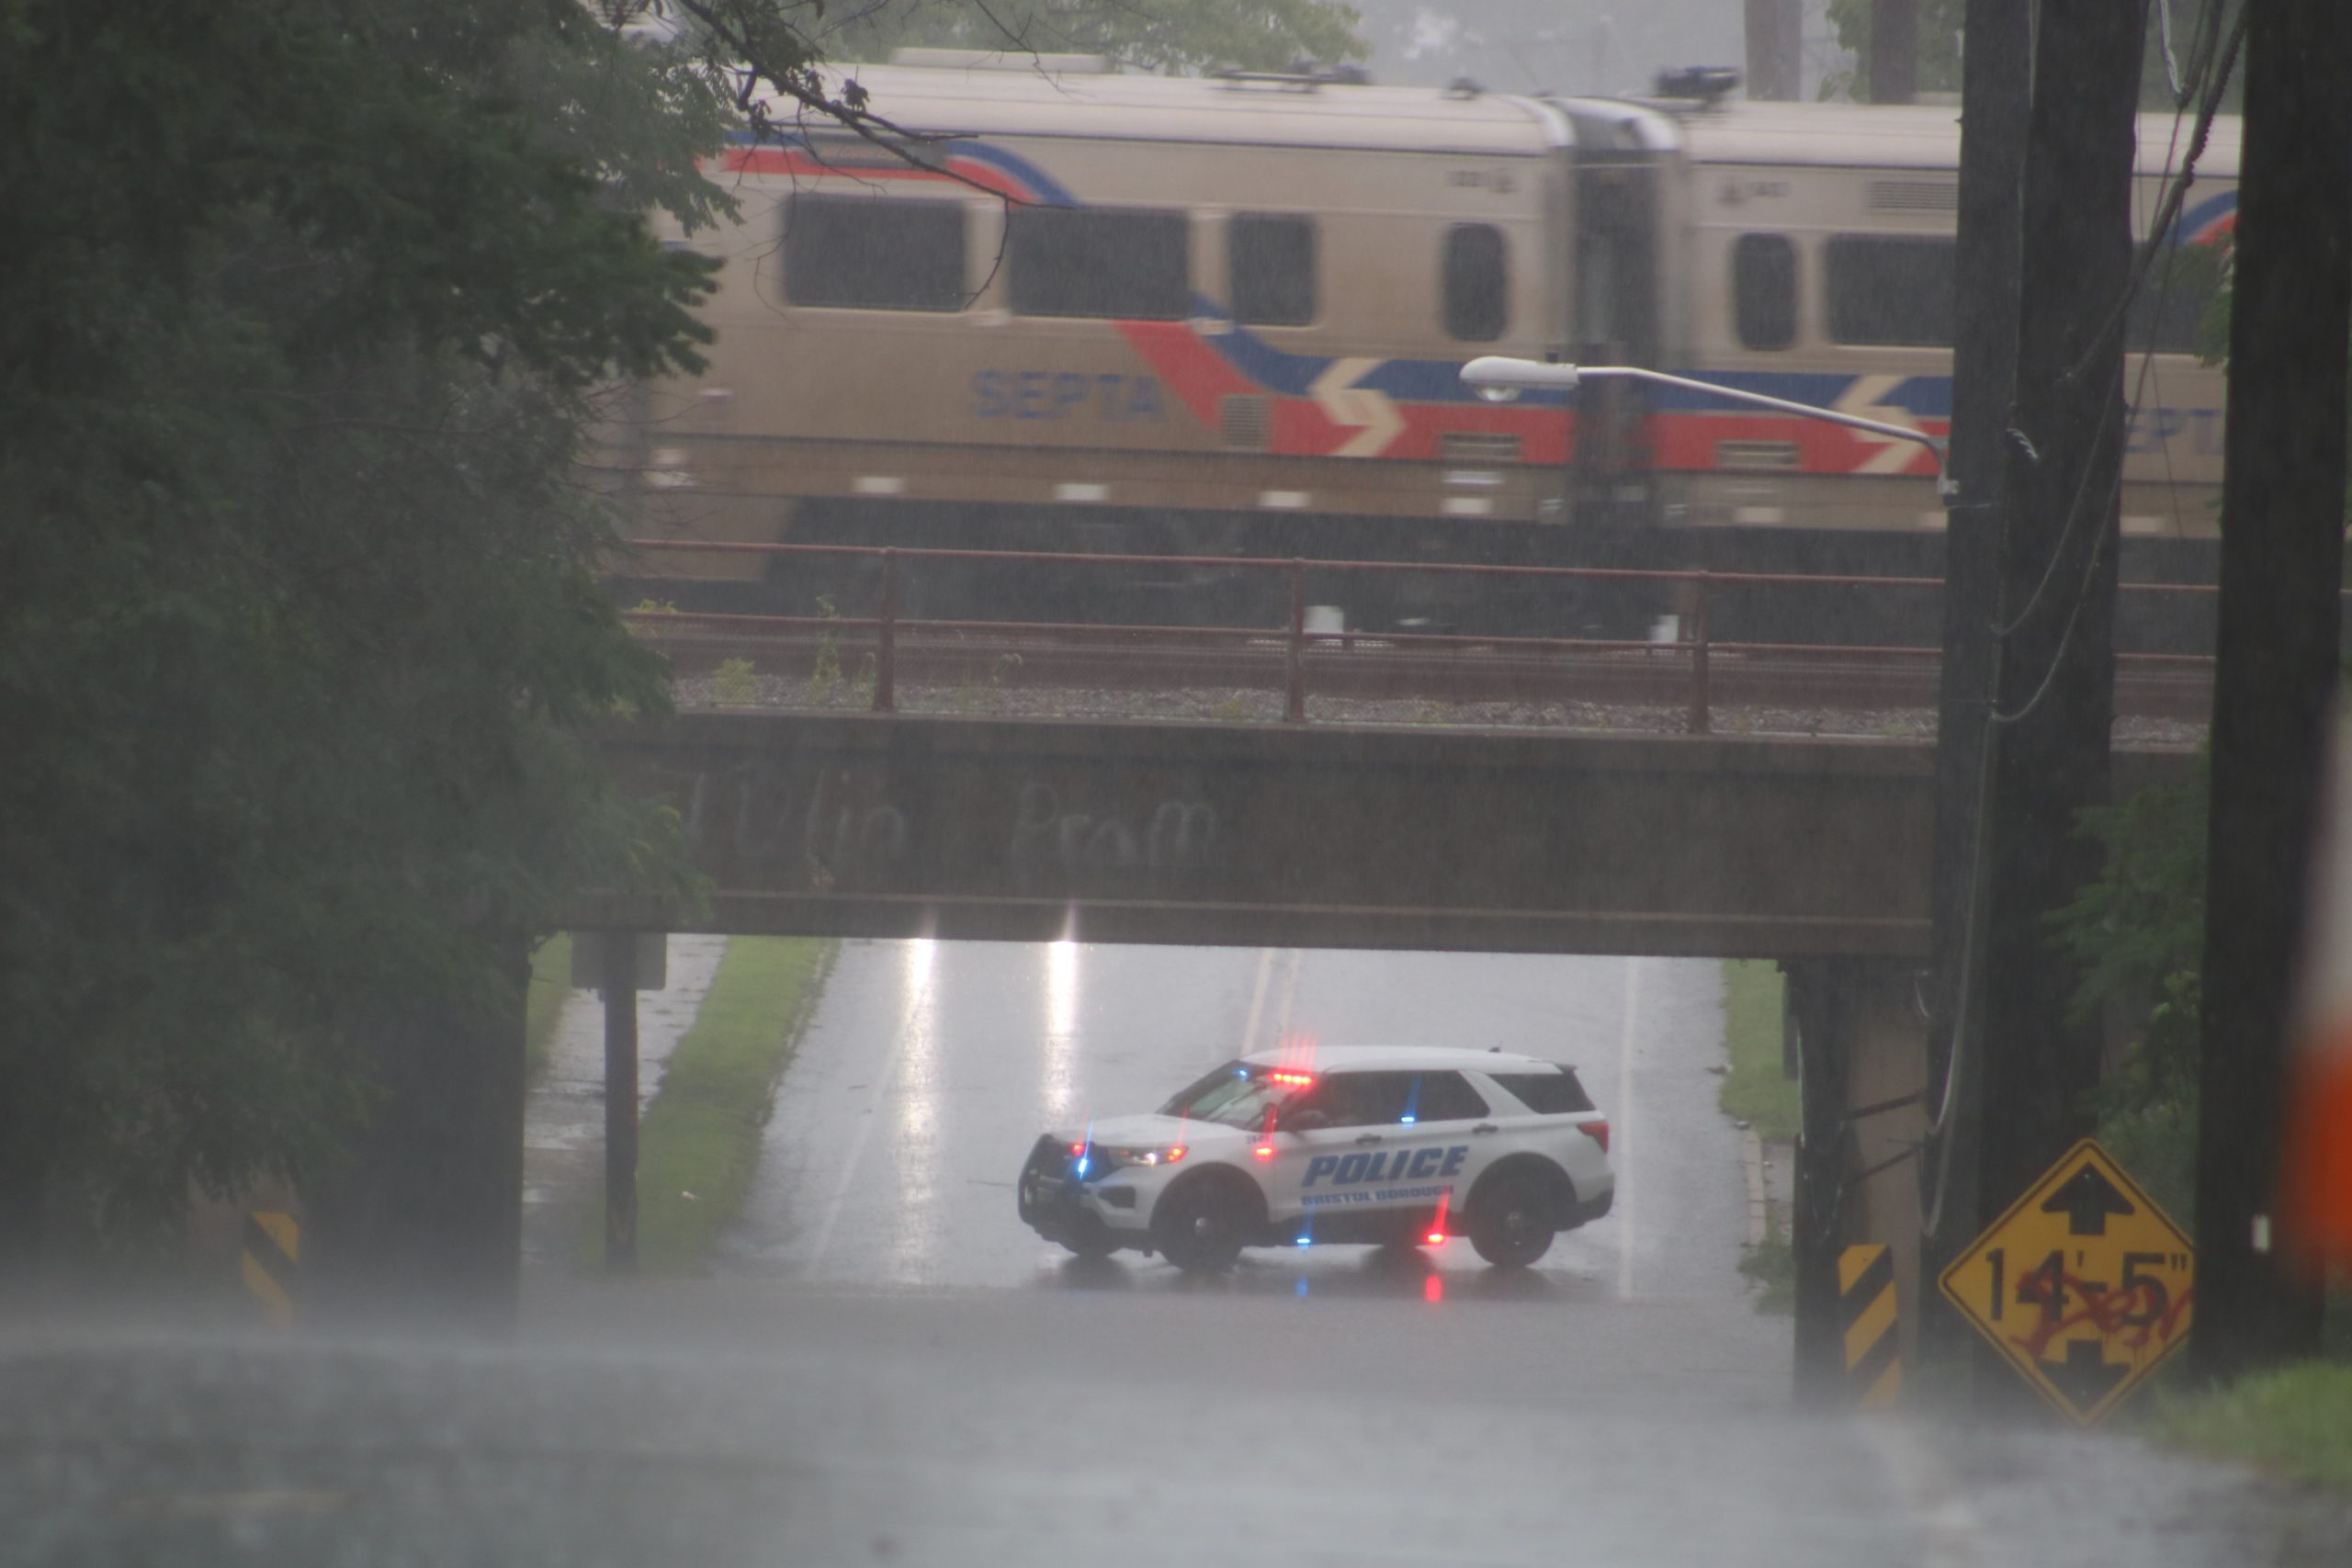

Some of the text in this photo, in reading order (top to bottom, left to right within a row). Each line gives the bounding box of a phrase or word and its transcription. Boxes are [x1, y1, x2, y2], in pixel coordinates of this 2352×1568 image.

[970, 370, 1170, 424] SEPTA
[2123, 407, 2222, 455] EPT
[1301, 1145, 1469, 1188] POLICE
[1300, 1185, 1454, 1207] BRISTOL BOROUGH
